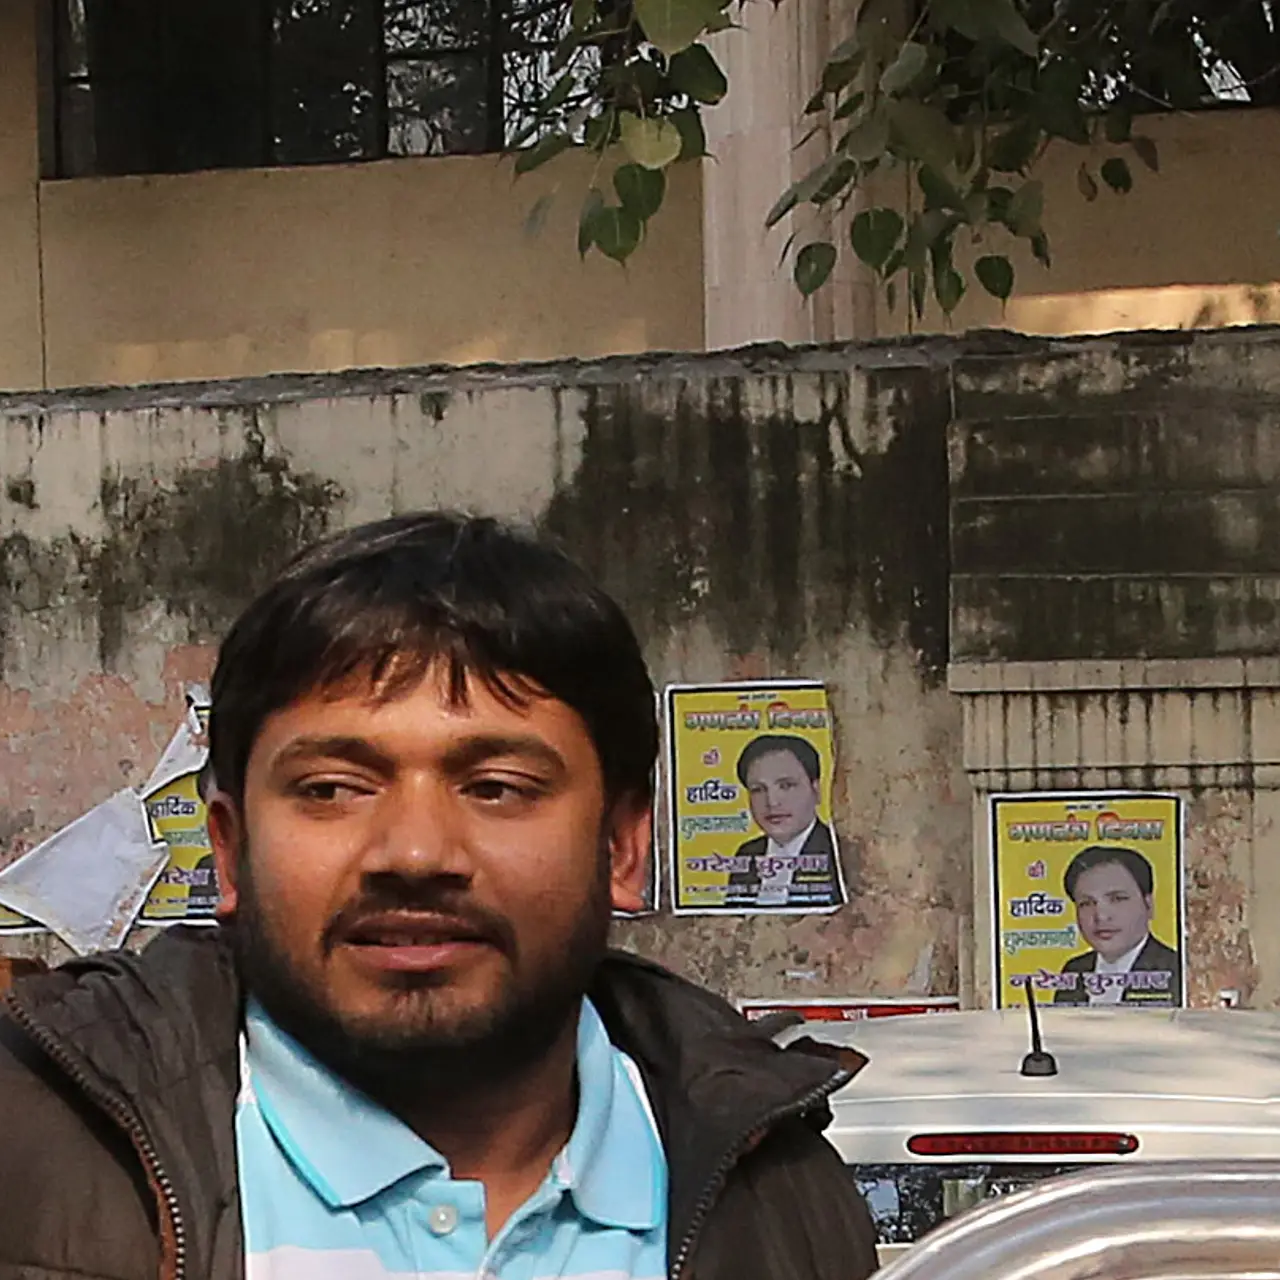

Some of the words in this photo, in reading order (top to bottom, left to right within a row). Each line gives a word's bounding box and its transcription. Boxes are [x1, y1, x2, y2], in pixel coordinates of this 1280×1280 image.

[768, 702, 828, 730] दिवस
[703, 748, 719, 765] की
[686, 779, 737, 803] हार्दिक
[1096, 812, 1164, 840] दिवस
[686, 851, 749, 872] नरेश
[756, 856, 829, 878] कुमार
[1027, 860, 1045, 877] की
[1010, 893, 1063, 916] हार्दिक
[1010, 969, 1079, 990] नरेश
[1084, 971, 1171, 995] कुमार
